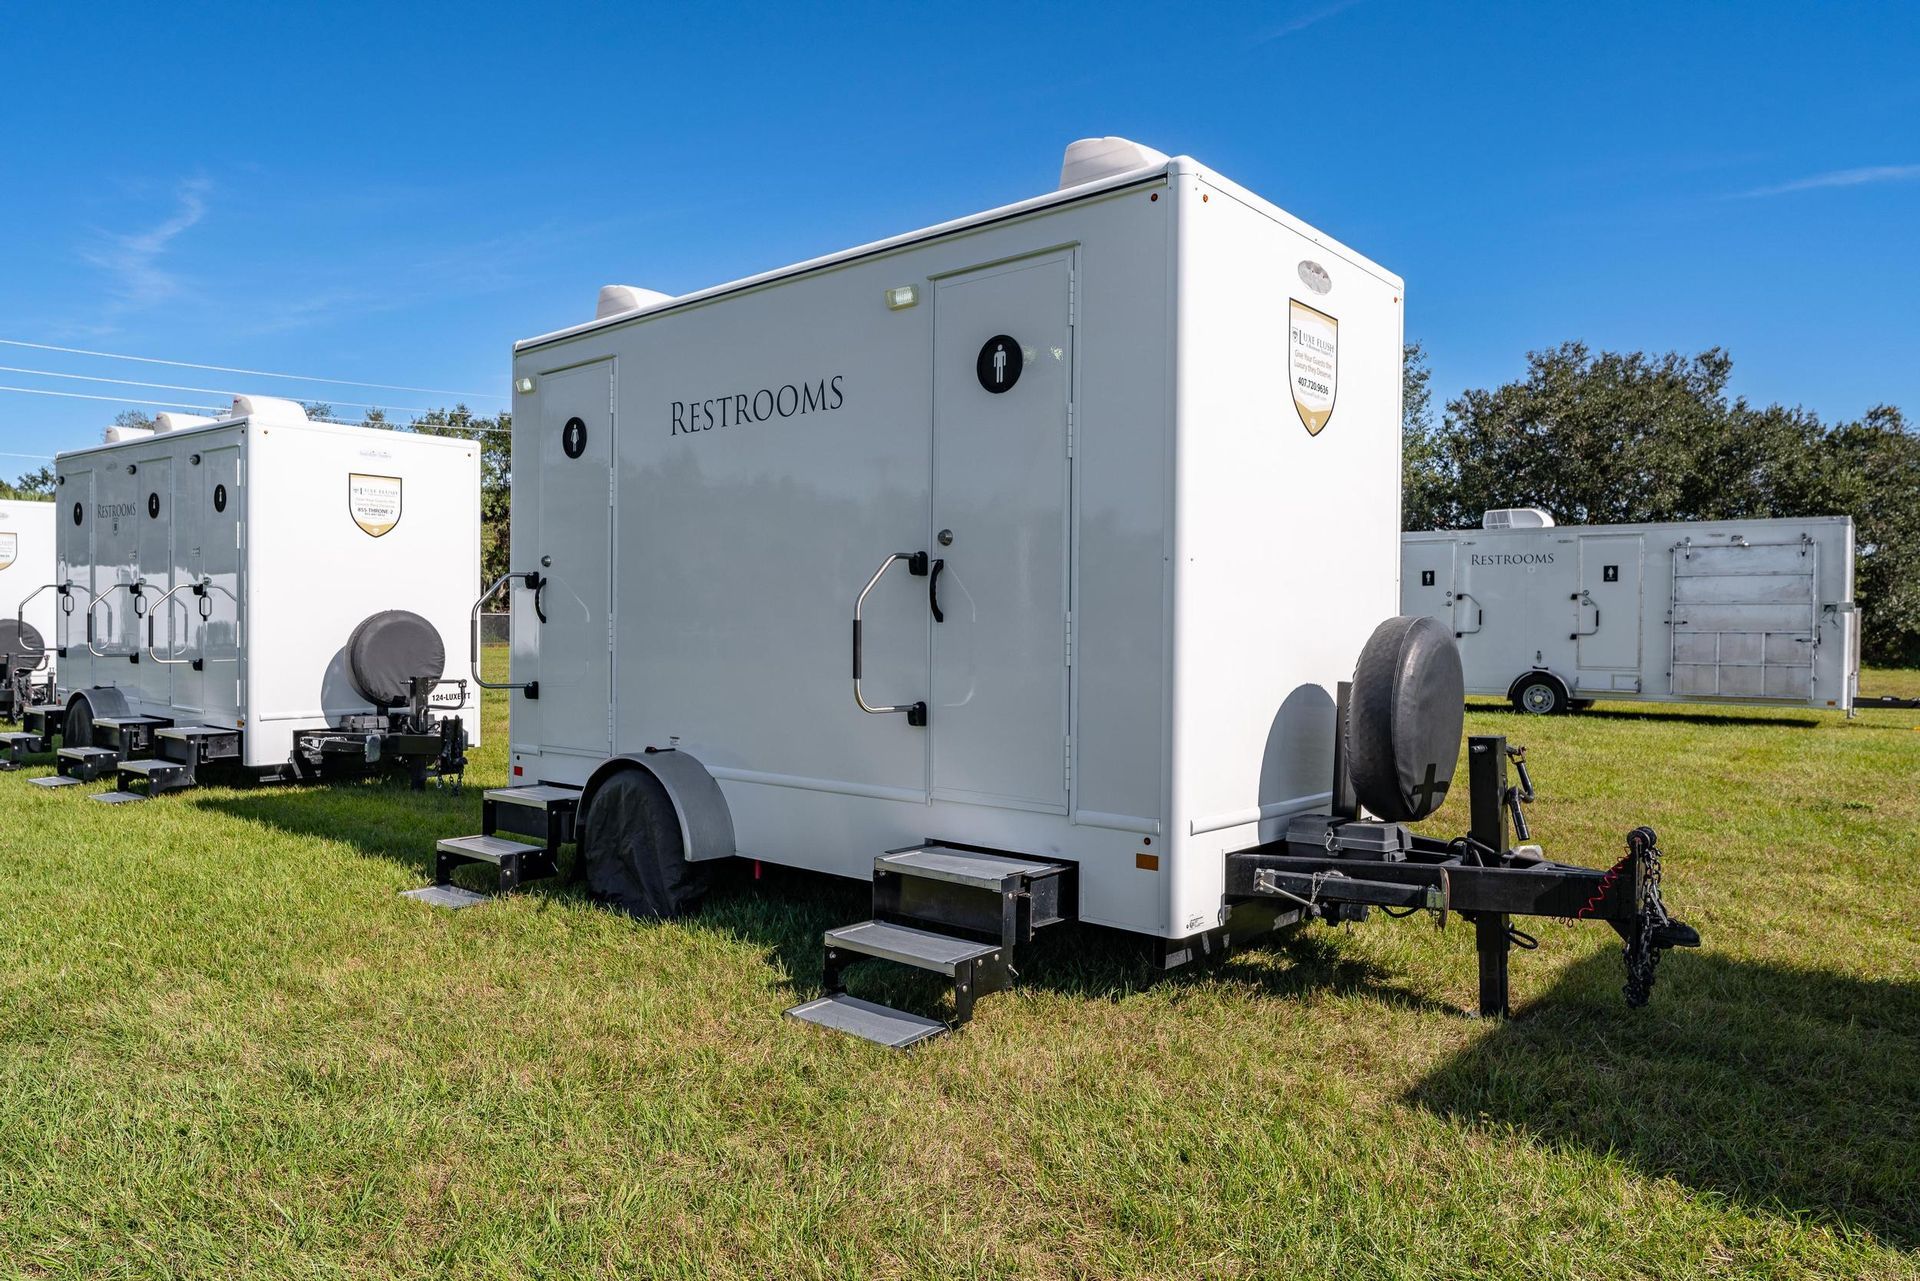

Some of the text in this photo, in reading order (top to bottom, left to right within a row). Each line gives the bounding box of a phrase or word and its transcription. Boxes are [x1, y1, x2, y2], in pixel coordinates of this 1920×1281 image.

[671, 375, 844, 436] RESTROOMS
[97, 502, 136, 519] RESTROOMS
[1471, 553, 1554, 566] RESTROOMS
